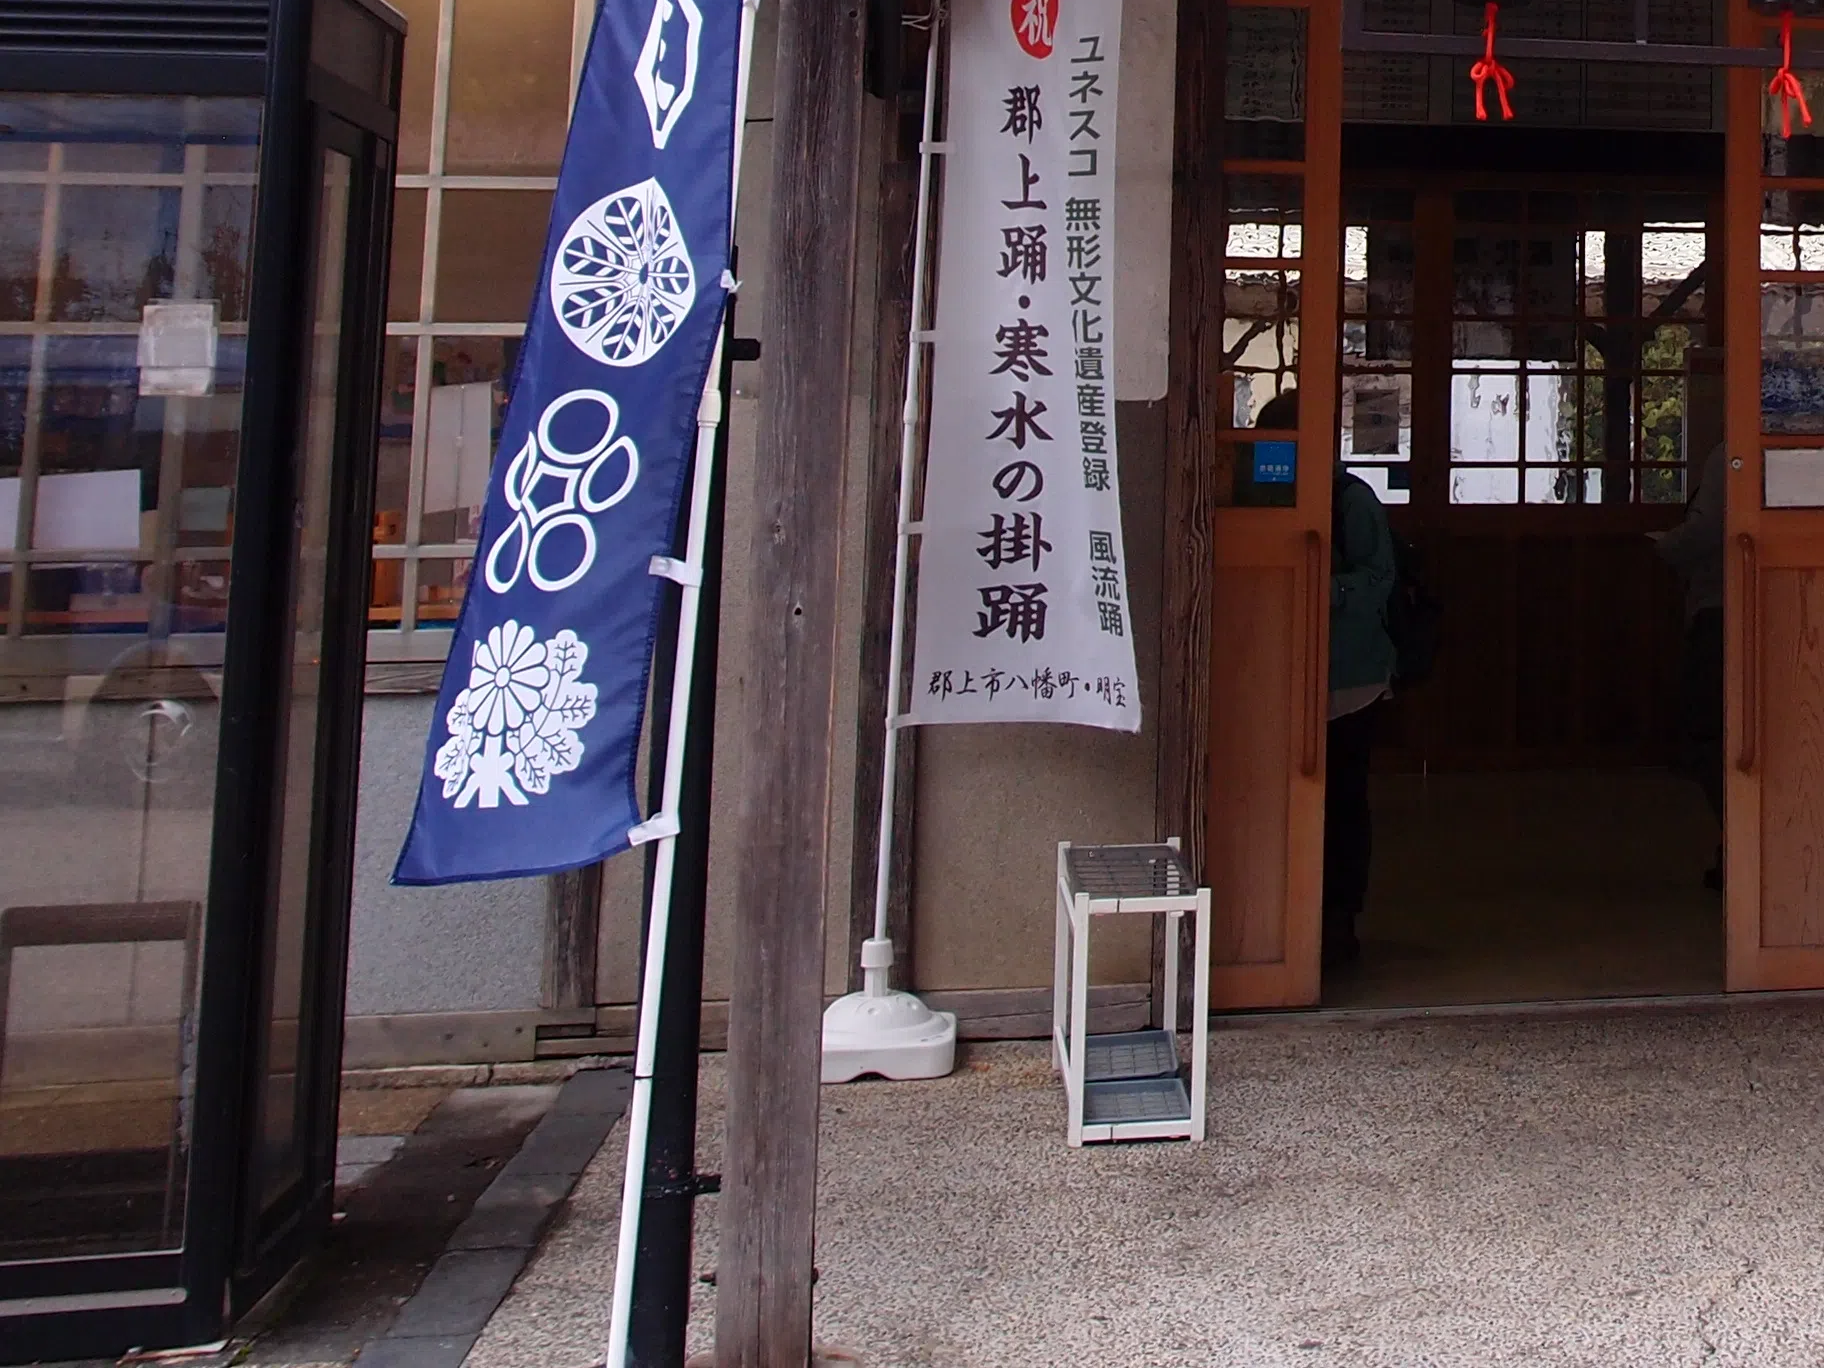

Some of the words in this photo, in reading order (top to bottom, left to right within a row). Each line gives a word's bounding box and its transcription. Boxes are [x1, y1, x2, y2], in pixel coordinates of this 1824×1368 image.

[1068, 36, 1105, 177] ユネスコ
[972, 84, 1055, 644] 郡上踊・寒水の掛踊
[1065, 197, 1111, 492] 無形文化遺産登録
[1089, 529, 1124, 638] 風流踊
[928, 667, 1127, 708] 郡上市八幡町・明宝
